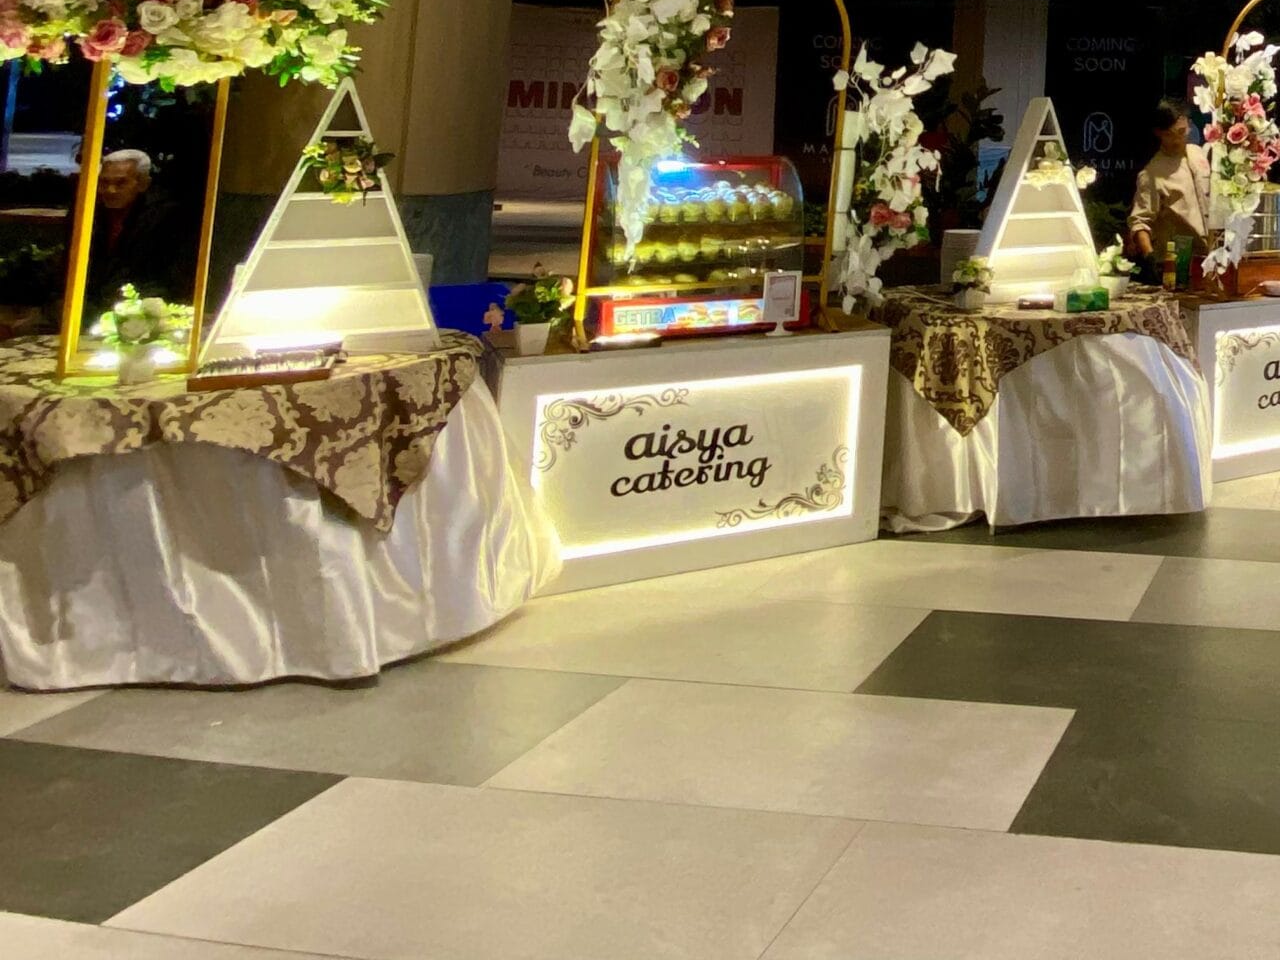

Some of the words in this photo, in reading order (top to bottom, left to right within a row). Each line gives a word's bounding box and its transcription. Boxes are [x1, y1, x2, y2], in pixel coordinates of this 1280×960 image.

[1073, 57, 1127, 72] SOON
[624, 423, 754, 464] aisya
[610, 453, 773, 497] catering
